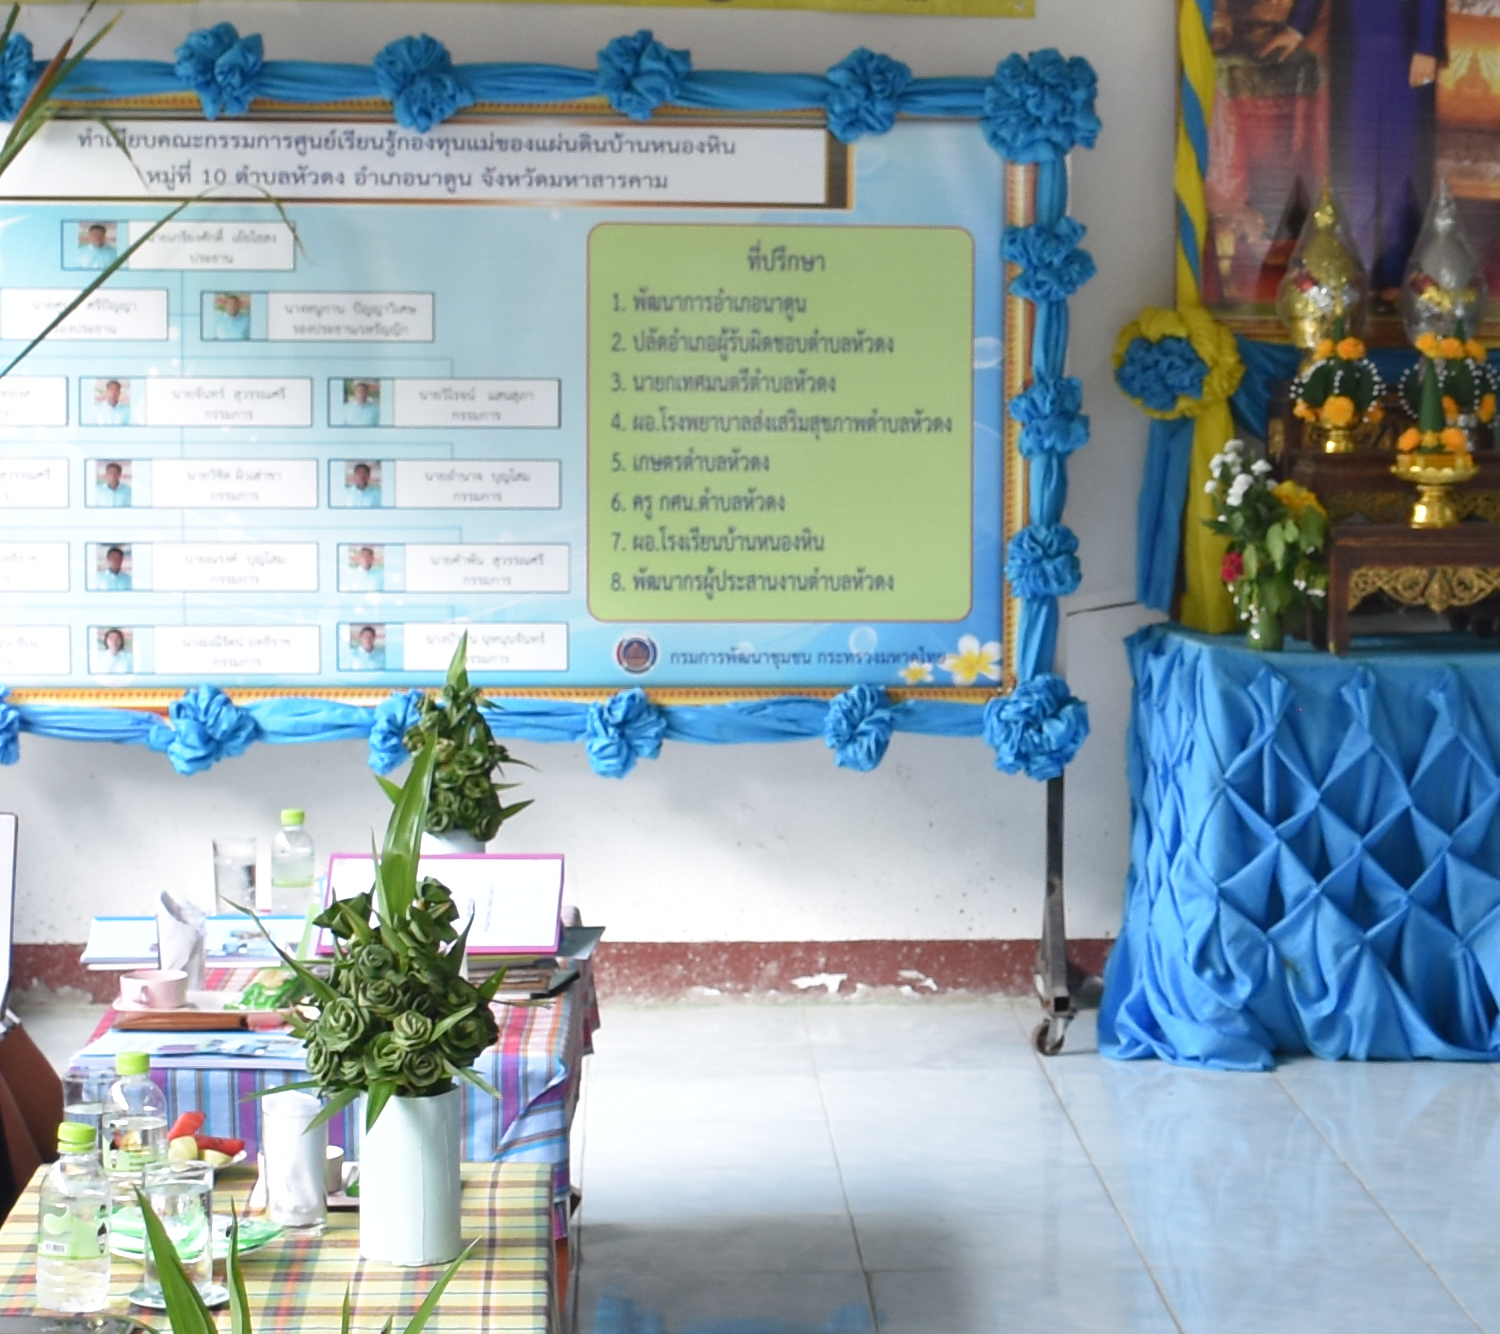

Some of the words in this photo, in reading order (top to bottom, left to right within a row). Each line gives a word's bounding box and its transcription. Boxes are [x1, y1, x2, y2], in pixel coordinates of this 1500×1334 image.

[146, 160, 193, 193] หมู่ที่
[202, 169, 228, 186] 10
[236, 163, 346, 188] ตำบลหัวดง
[354, 166, 473, 194] อำเภอนาดูน
[481, 168, 669, 192] จังหวัดมหาสารคาม
[746, 240, 827, 273] ที่ปรึกษา
[610, 293, 627, 312] 1.
[632, 287, 808, 323] พัฒนาการอำเภอนาดูน
[610, 333, 627, 353] 2.
[632, 326, 896, 362] ปลัดอำเภอผู้รับผิดชอบตำบลหัวดง
[610, 372, 627, 393] 3.
[632, 367, 837, 394] นายกเทศมนตรีตำบลหัวดง
[610, 412, 627, 432] 4.
[632, 406, 954, 441] ผอ.โรงพยาบาลส่งเสริมสุขภาพตำบลหัวดง
[610, 453, 627, 472] 5.
[632, 447, 771, 473] เกษตรตำบลหัวดง
[610, 493, 627, 512] 6.
[632, 494, 655, 520] ครู
[659, 487, 787, 514] กศน.ตำบลหัวดง
[610, 532, 627, 552] 7.
[632, 525, 826, 553] ผอ.โรงเรียนบ้านหนองหิน
[610, 572, 627, 592] 8.
[632, 566, 896, 600] พัฒนากรผู้ประสานงานตำบลหัวดง
